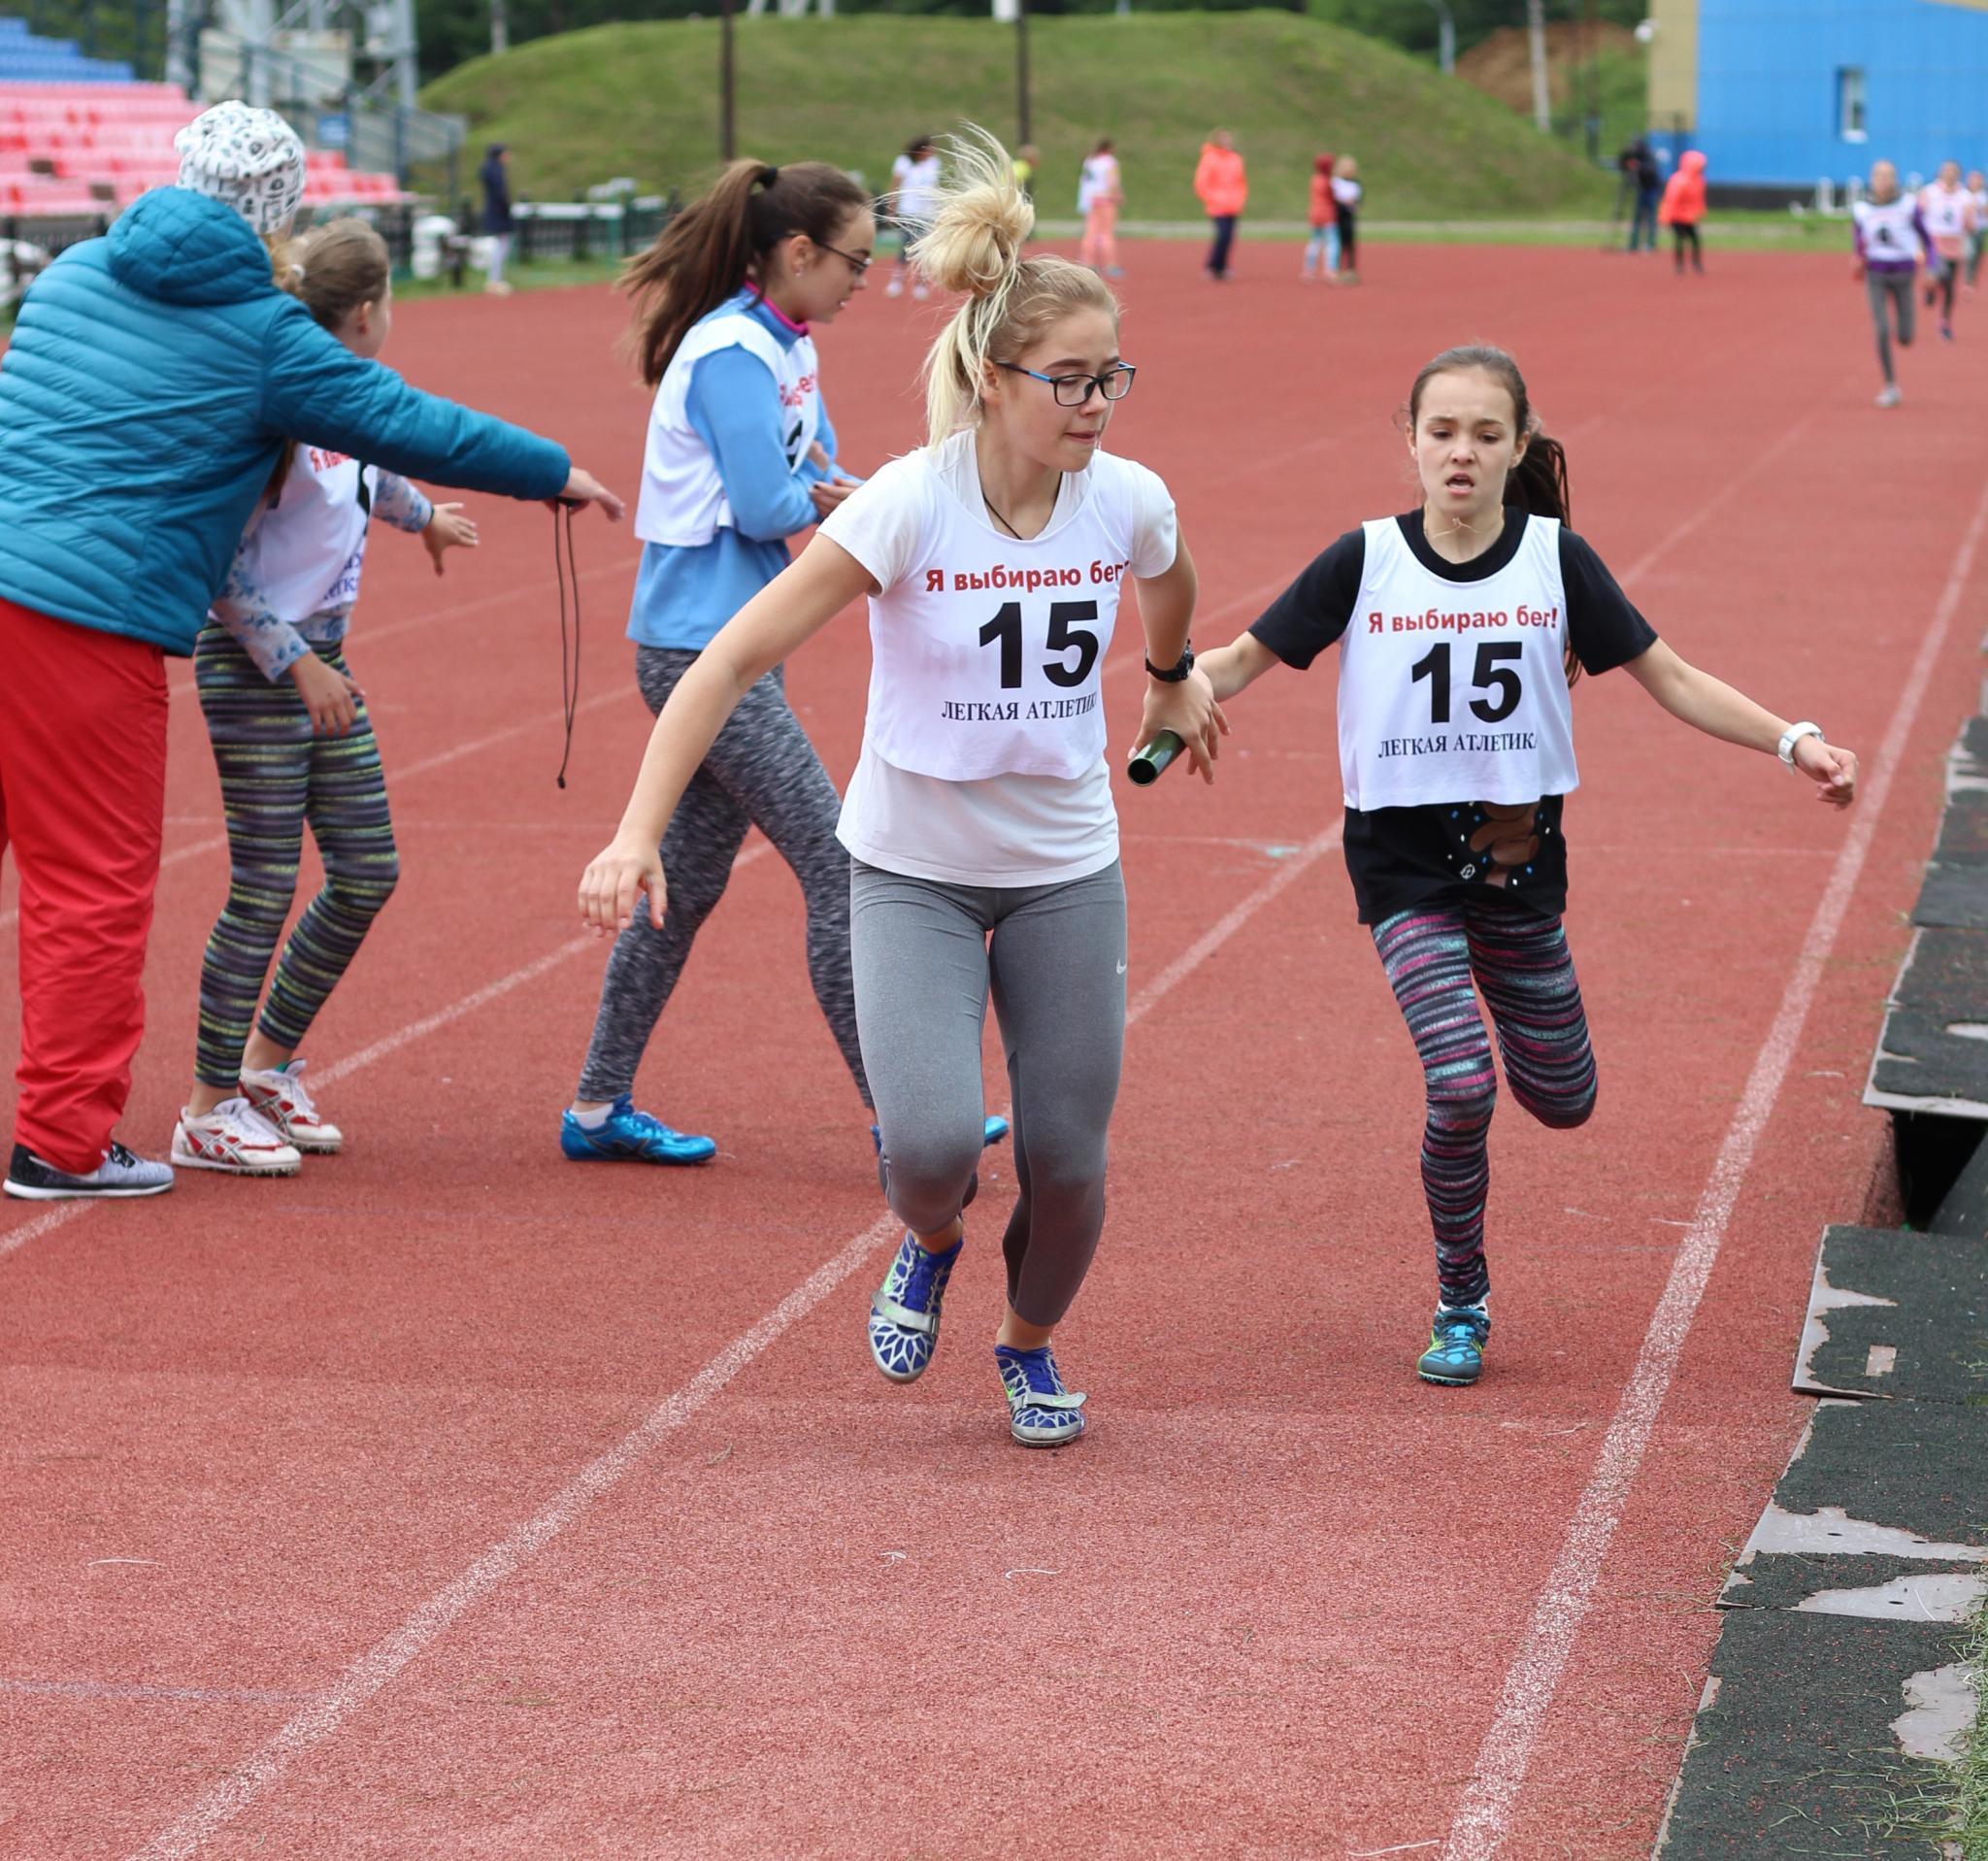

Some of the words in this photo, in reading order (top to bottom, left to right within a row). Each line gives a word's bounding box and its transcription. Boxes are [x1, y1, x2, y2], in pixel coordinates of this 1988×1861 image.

[926, 569, 944, 592] Я
[954, 564, 1081, 593] выбираю
[1369, 612, 1383, 633] Я
[1392, 608, 1508, 634] выбираю
[1516, 605, 1558, 629] бег!
[978, 599, 1099, 689] 15
[1411, 641, 1522, 724] 15
[941, 700, 1019, 721] ЛЕГКАЯ
[1026, 690, 1097, 720] АТЛЕТИК
[1378, 735, 1448, 759] ЛЕГКАЯ
